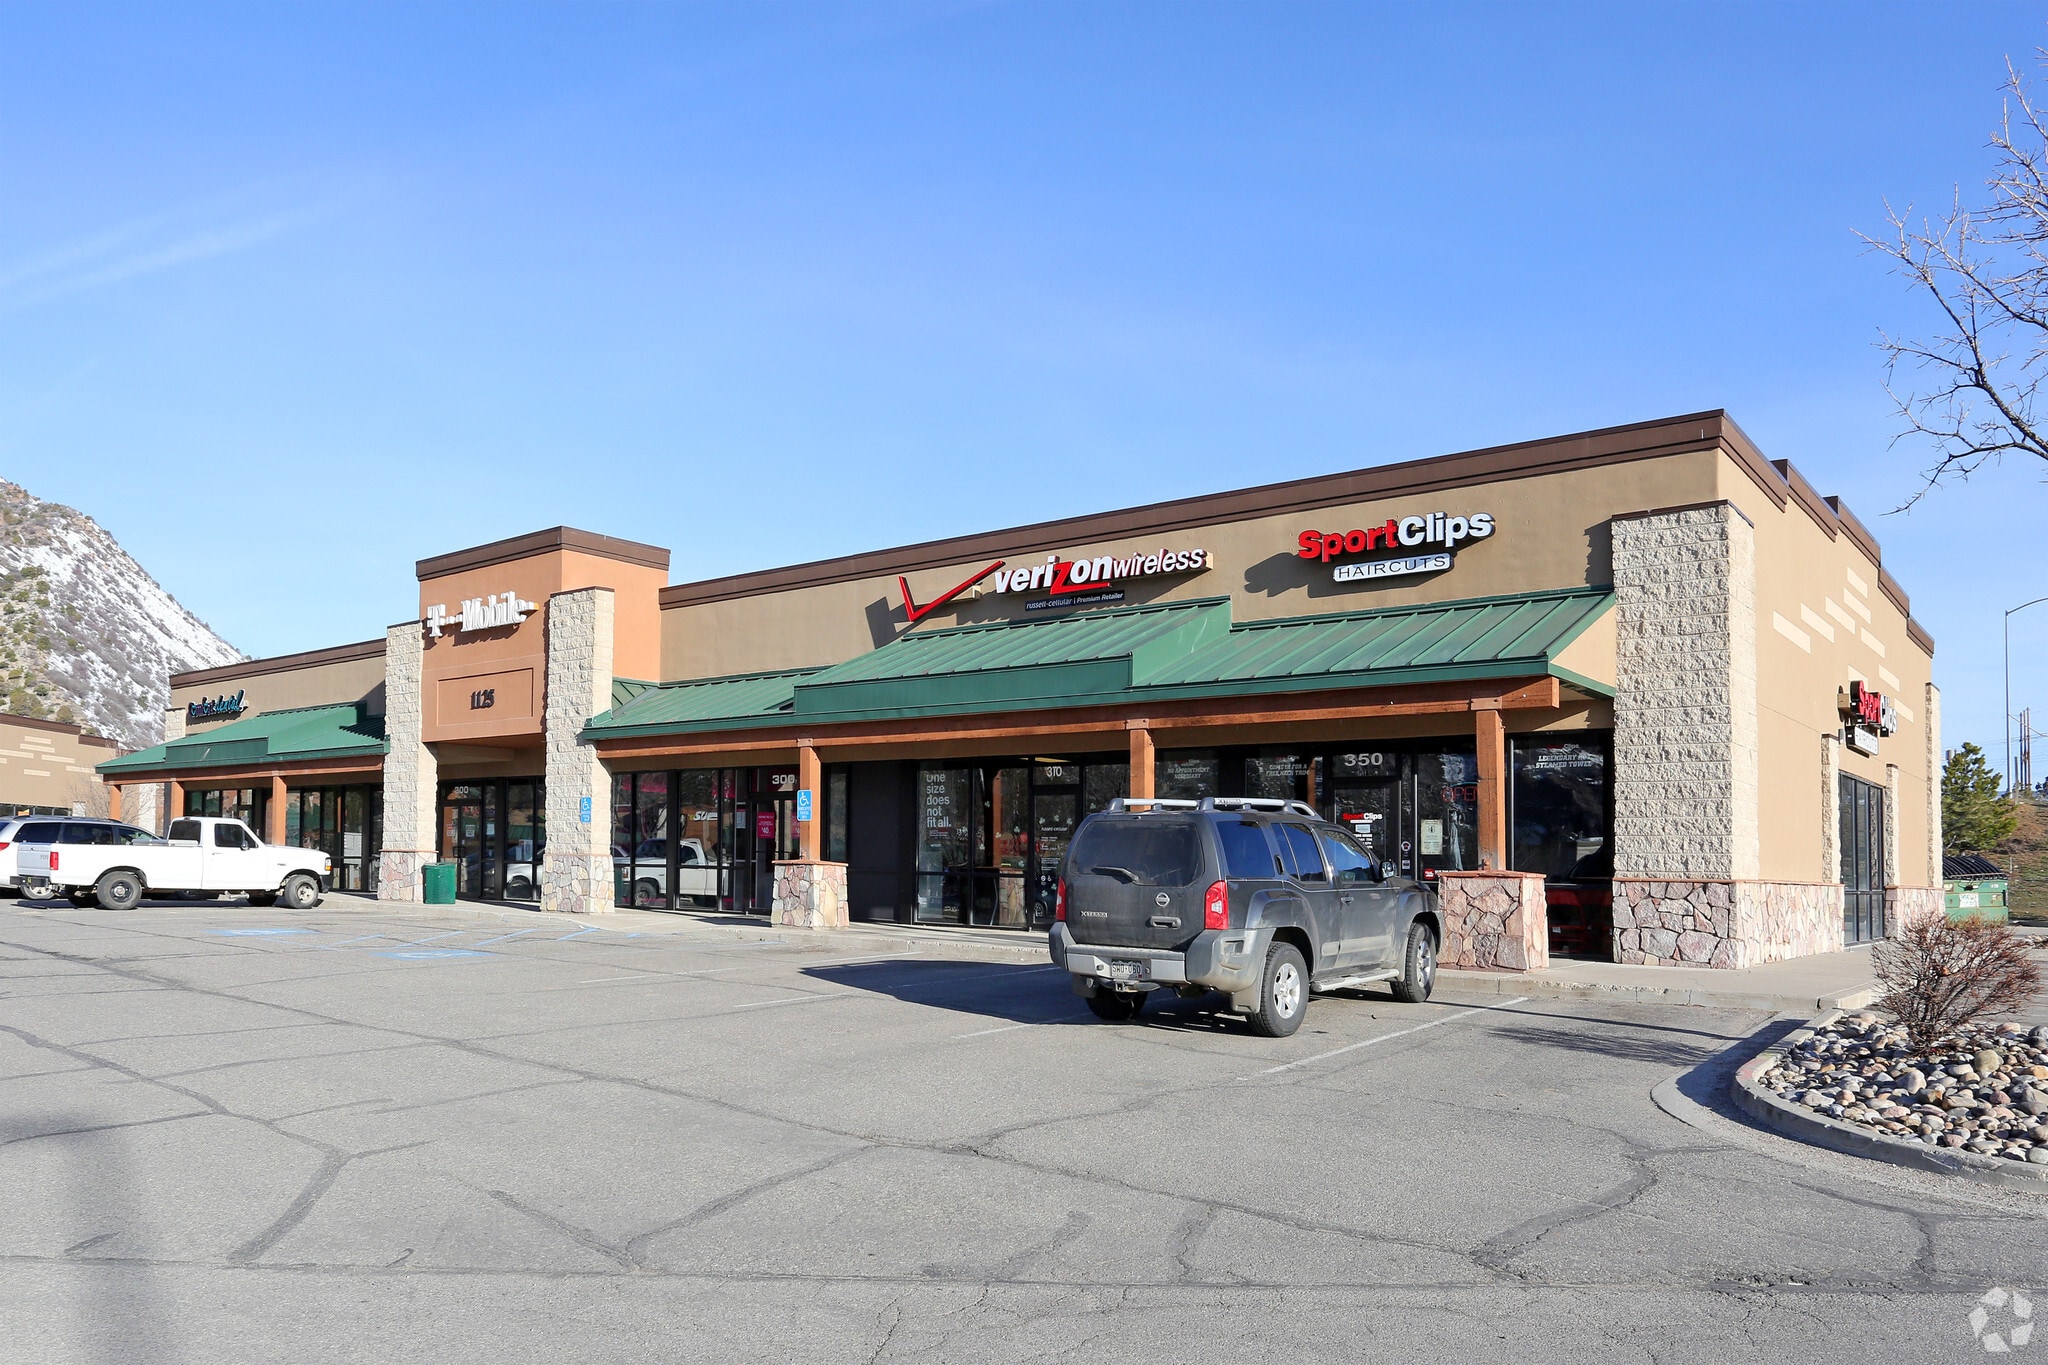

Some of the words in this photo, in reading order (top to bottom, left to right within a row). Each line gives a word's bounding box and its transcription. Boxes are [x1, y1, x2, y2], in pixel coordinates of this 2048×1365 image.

[1338, 556, 1446, 579] HAIRCUTS
[1077, 595, 1101, 604] Premium
[1101, 592, 1124, 601] Retailer
[470, 689, 495, 710] 1125
[1344, 753, 1383, 766] 350
[1535, 761, 1567, 769] STEAMED
[772, 774, 795, 785] 300
[926, 782, 945, 794] size
[926, 794, 950, 806] does
[926, 805, 943, 817] not
[926, 816, 937, 828] fit
